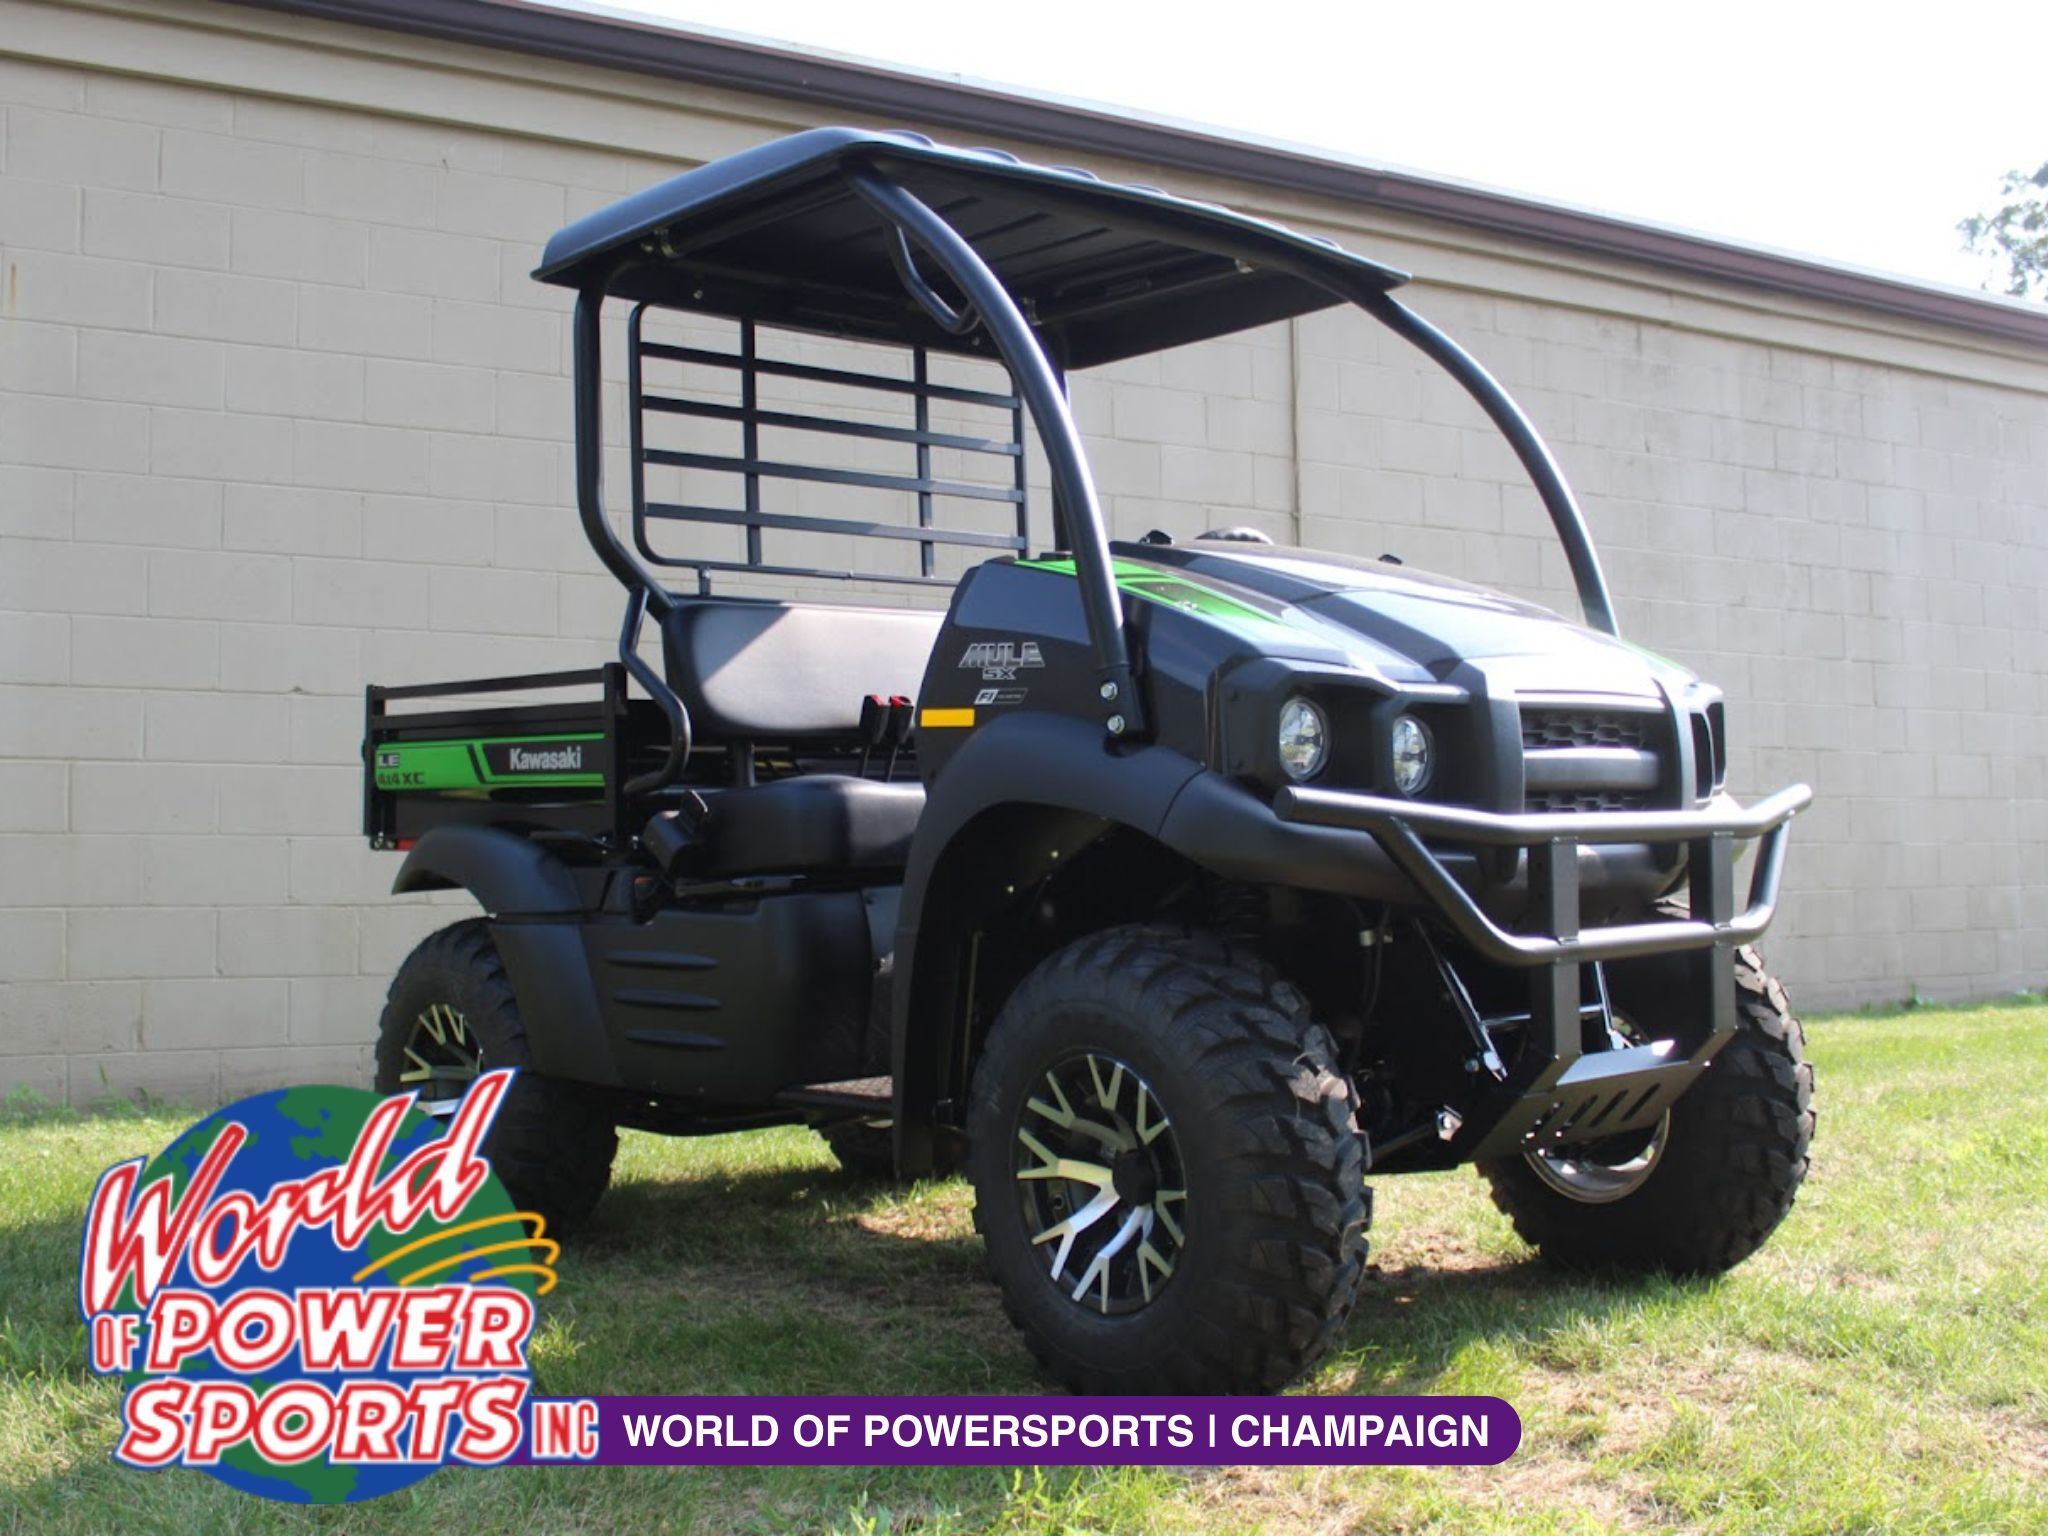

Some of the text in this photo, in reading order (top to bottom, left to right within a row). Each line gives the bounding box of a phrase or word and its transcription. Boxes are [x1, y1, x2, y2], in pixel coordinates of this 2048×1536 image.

[958, 641, 1046, 668] MULE
[982, 666, 1017, 680] SX
[377, 753, 400, 768] LE
[509, 745, 582, 771] Kawasaki
